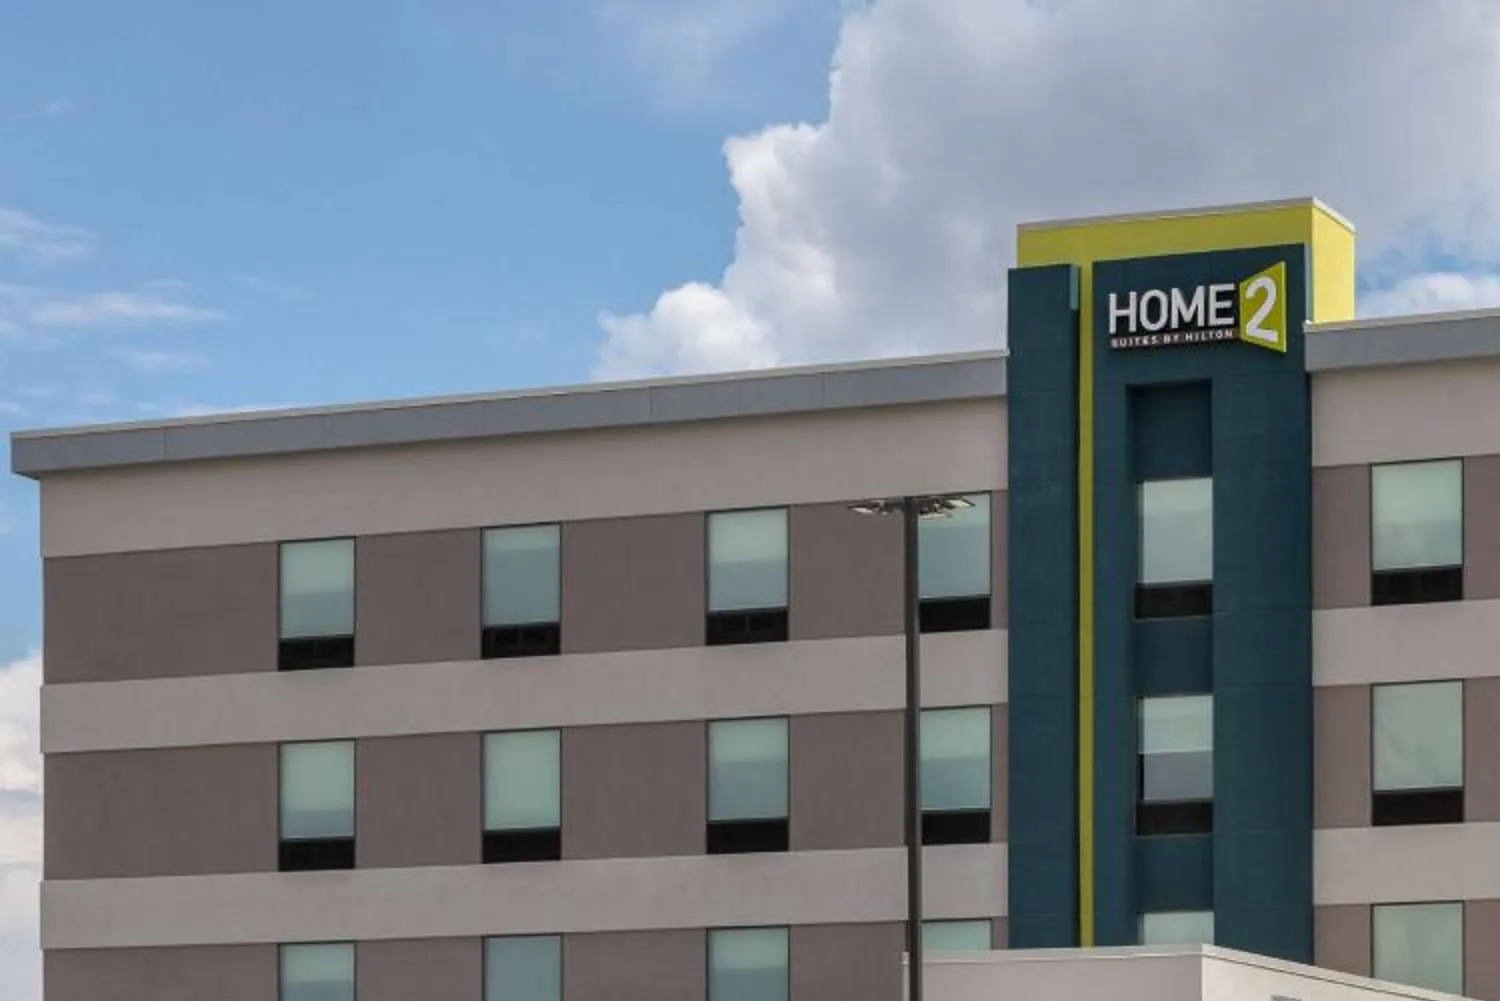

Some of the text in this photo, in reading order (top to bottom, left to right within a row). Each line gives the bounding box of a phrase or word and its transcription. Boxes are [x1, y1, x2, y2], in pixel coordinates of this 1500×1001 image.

[1108, 276, 1278, 343] HOME 2
[1111, 329, 1233, 349] SUITES BY HILTON
